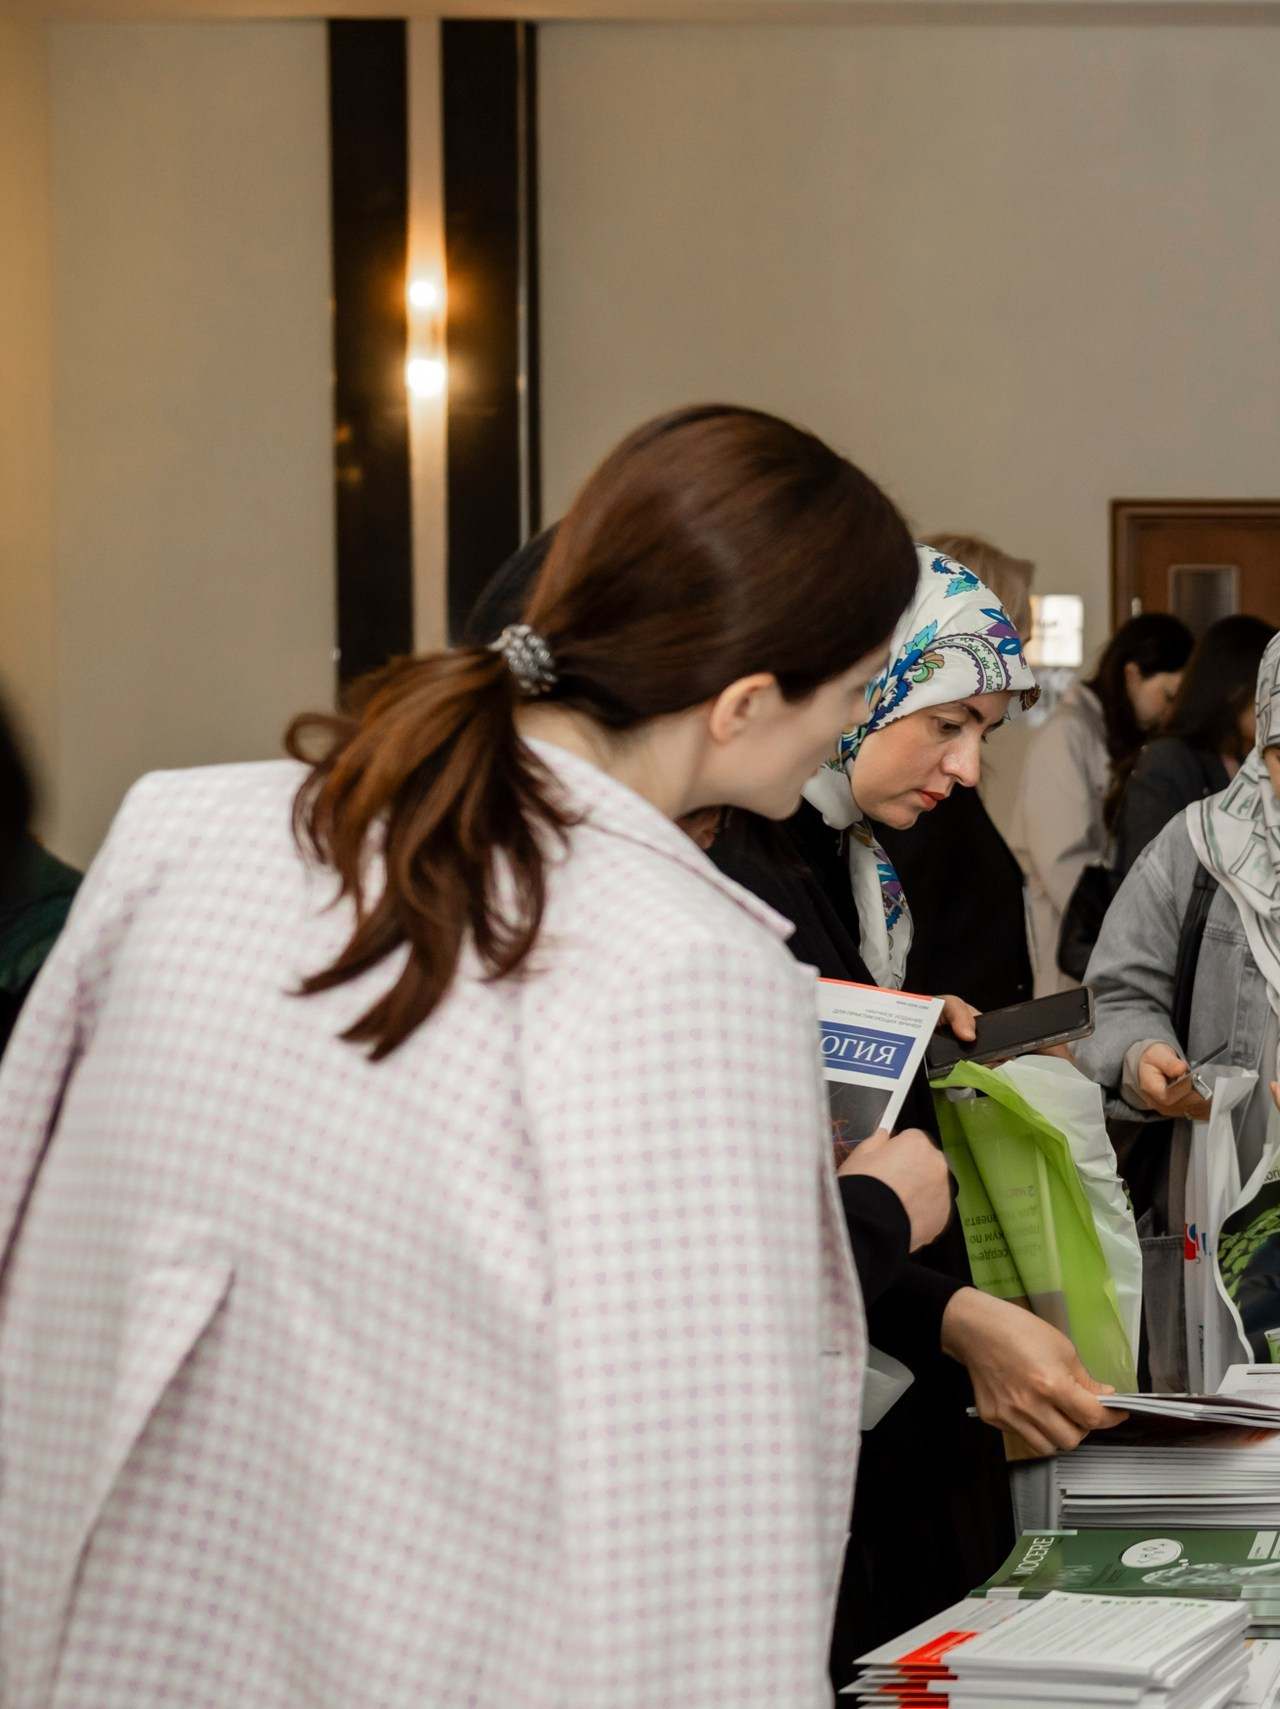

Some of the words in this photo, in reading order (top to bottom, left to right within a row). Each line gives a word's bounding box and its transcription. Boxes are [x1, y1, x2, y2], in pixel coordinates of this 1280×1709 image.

[821, 1035, 897, 1065] ОГИЯ
[969, 1234, 983, 1245] по
[1012, 1536, 1055, 1575] NOCERE
